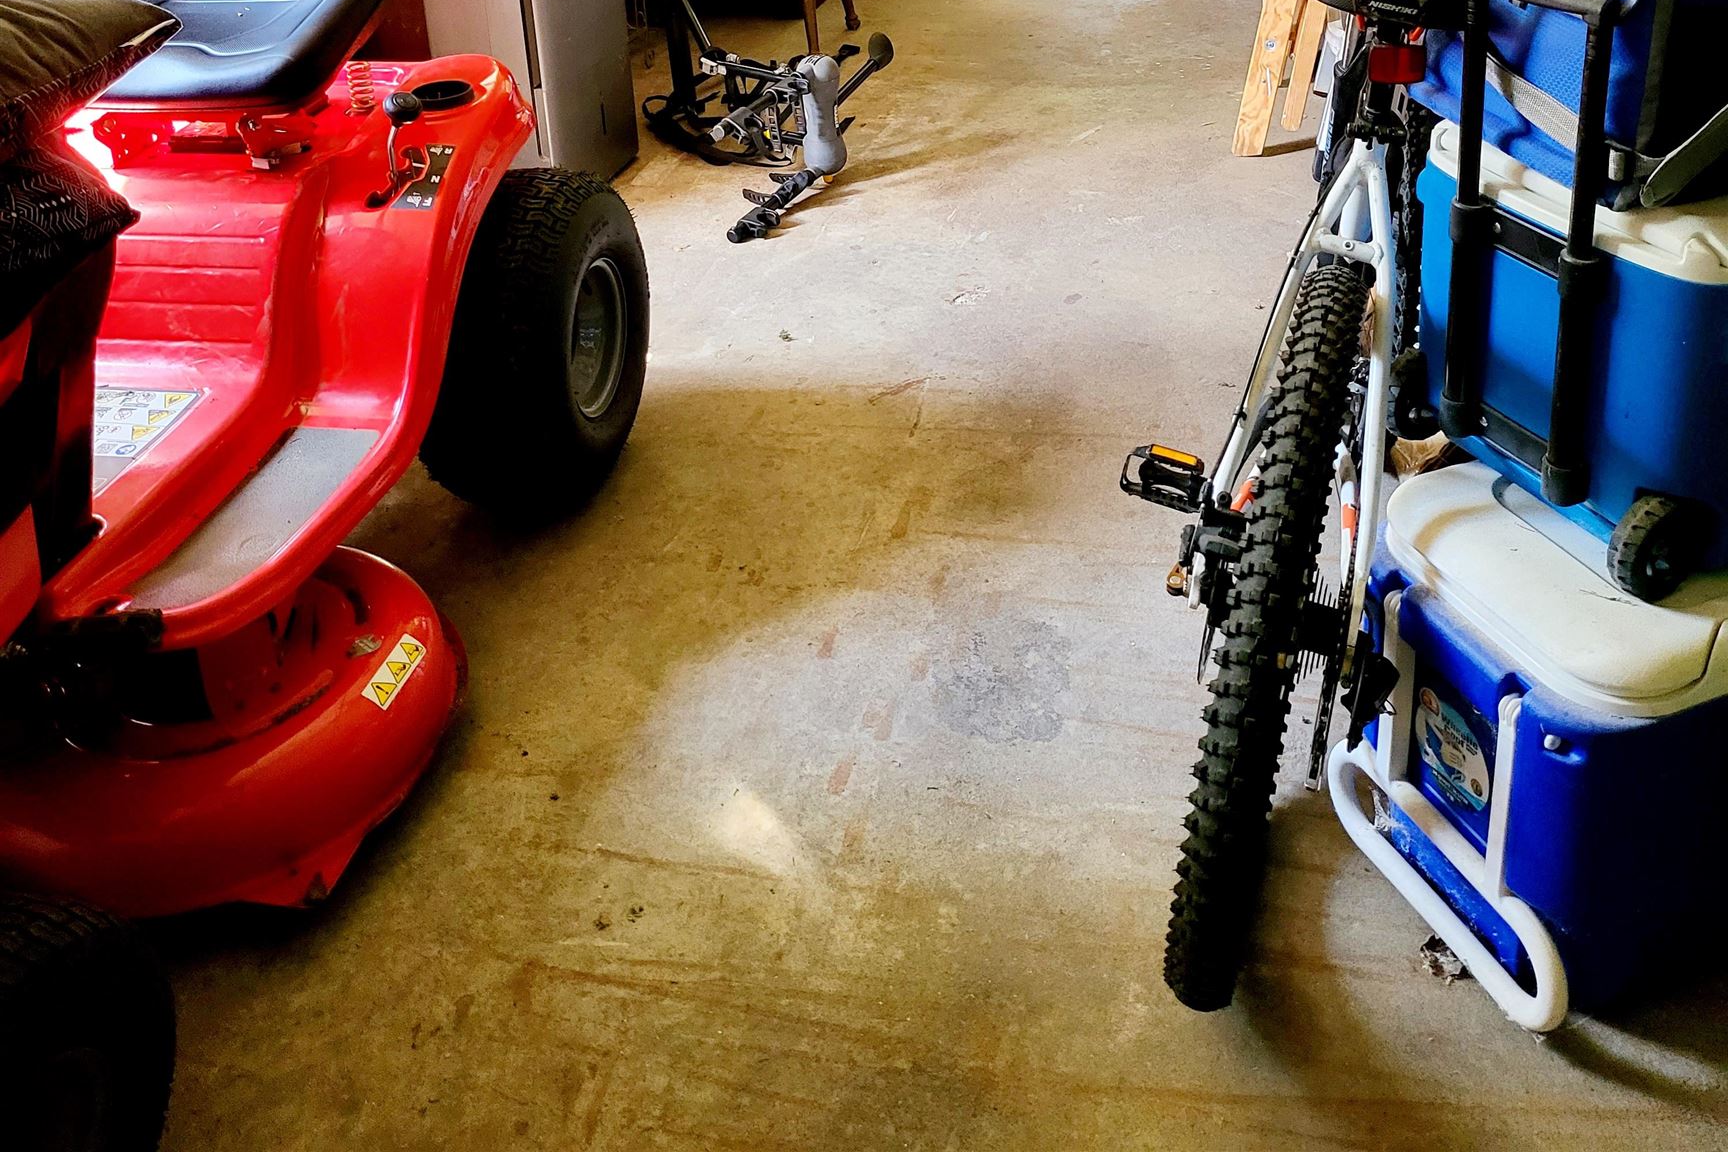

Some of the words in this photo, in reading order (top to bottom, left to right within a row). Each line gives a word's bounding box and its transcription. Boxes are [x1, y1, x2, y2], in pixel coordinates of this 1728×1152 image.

[1368, 0, 1418, 15] NISHIKI
[430, 175, 440, 183] N
[422, 197, 433, 206] F
